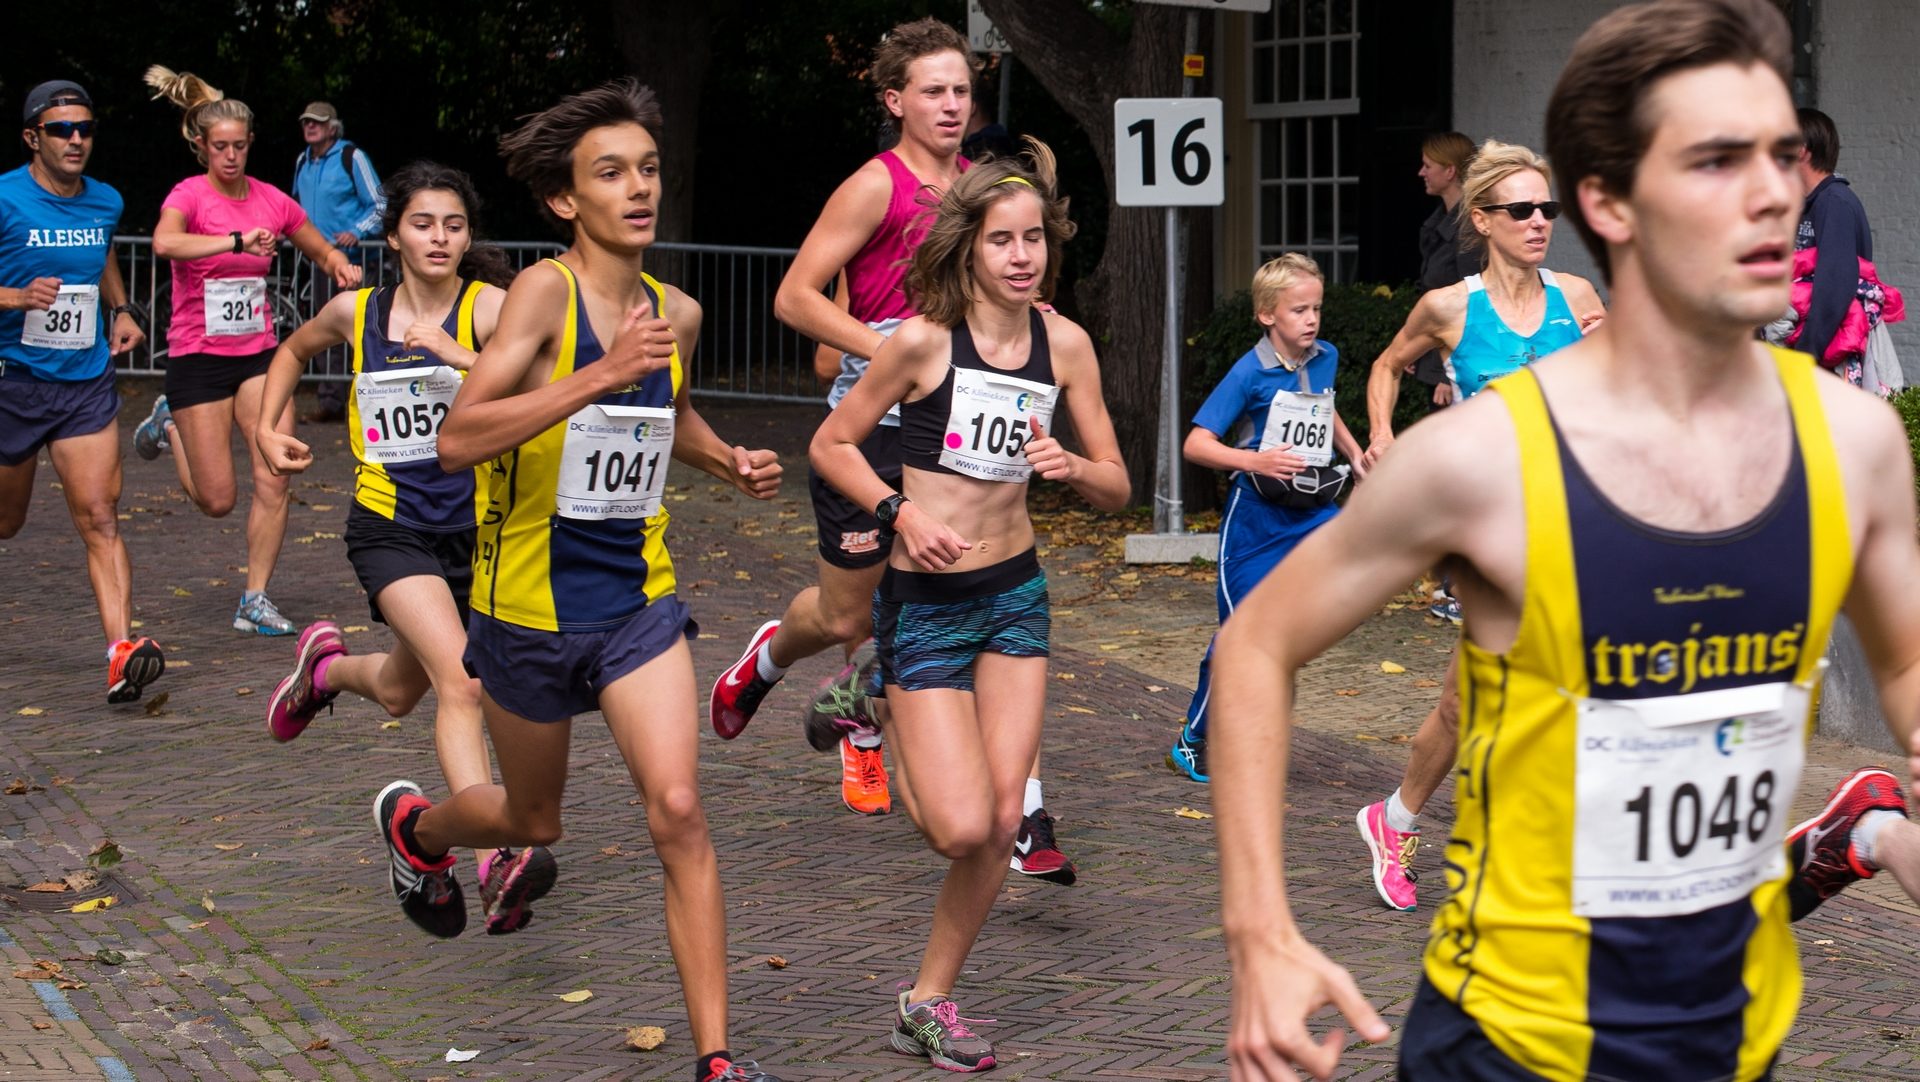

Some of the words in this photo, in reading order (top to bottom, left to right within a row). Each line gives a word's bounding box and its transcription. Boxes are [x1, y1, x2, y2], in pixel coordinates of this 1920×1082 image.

[1127, 117, 1211, 186] 16
[26, 228, 105, 247] ALEISHA
[45, 309, 82, 334] 381
[222, 299, 252, 321] 321
[956, 385, 969, 394] DC
[570, 422, 586, 432] DC
[1281, 419, 1327, 449] 1068
[585, 449, 661, 493] 1041
[841, 529, 880, 546] Zier
[1624, 769, 1776, 862] 1048
